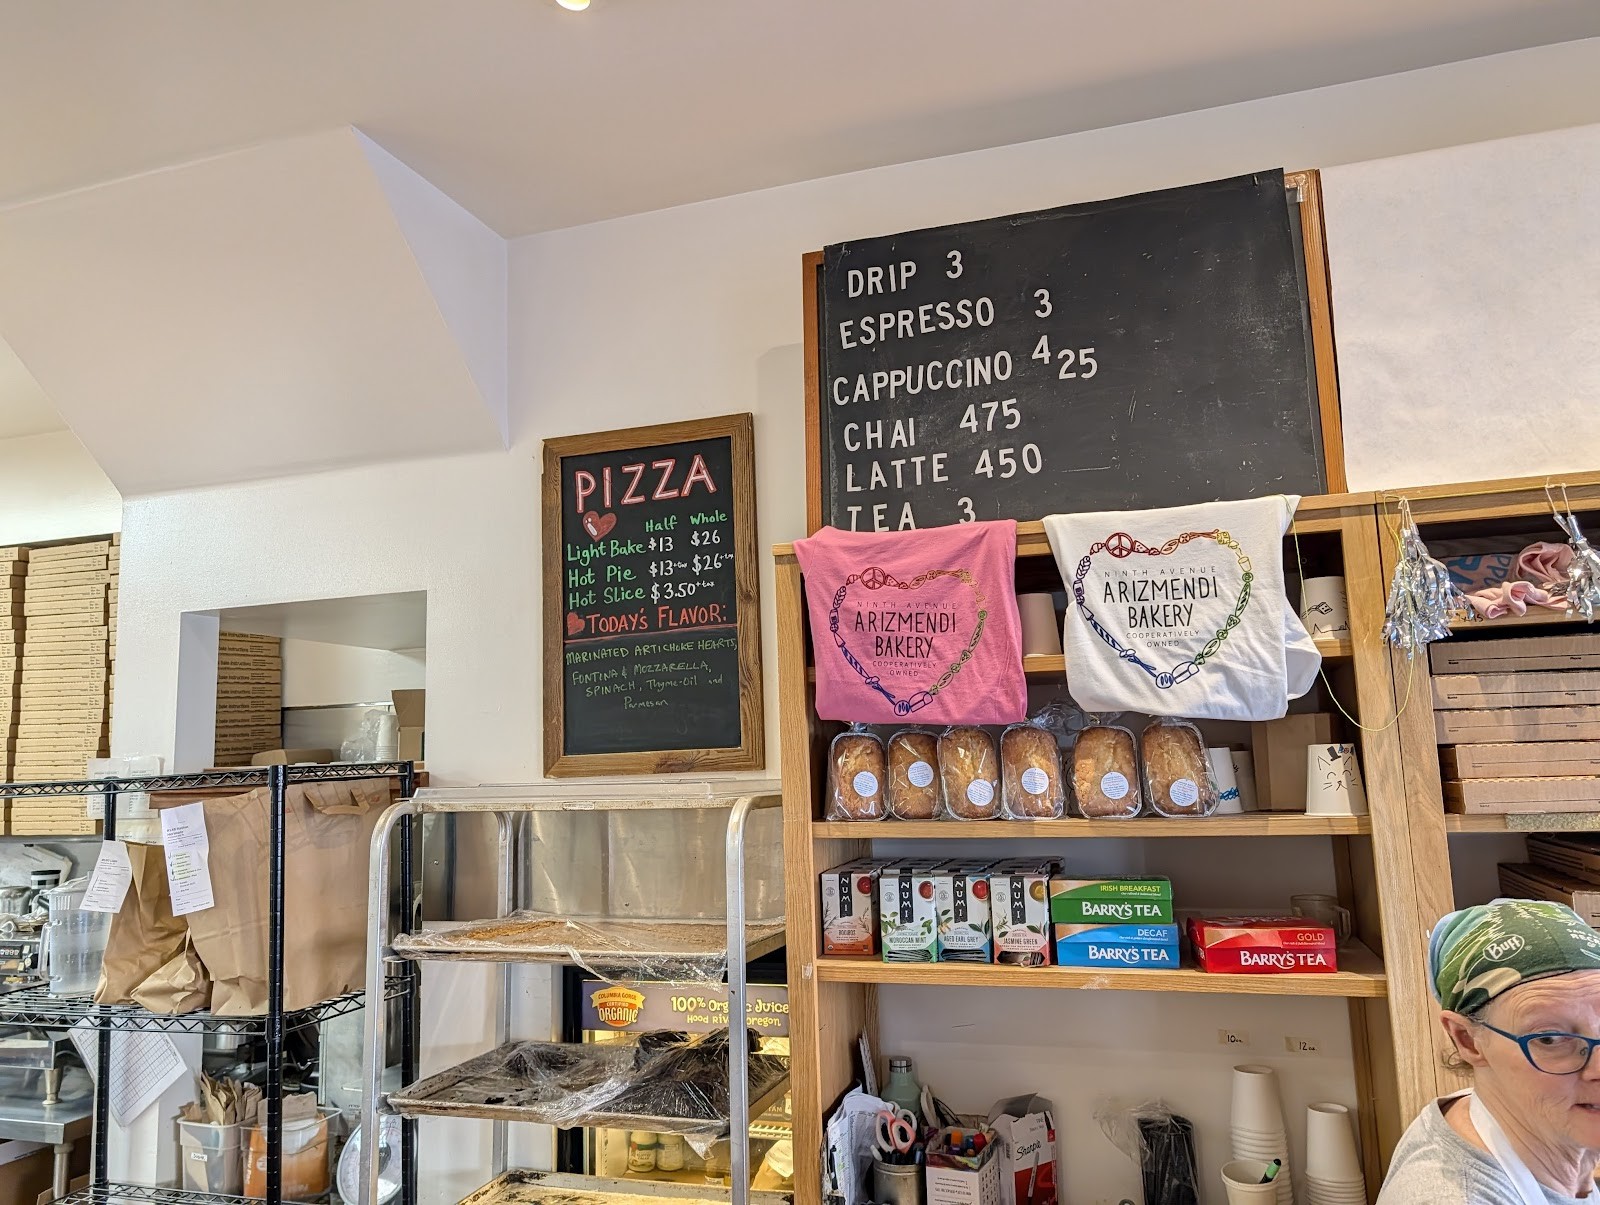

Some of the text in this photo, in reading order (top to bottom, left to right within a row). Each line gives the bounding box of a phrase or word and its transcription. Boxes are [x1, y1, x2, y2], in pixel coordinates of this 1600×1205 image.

[847, 249, 964, 298] DRIP 3
[839, 288, 1053, 350] ESPRESSO 3
[833, 334, 1099, 406] CAPPUCCINO 4 25
[843, 398, 1022, 452] CHAI 475
[845, 443, 1043, 493] LATTE 450
[575, 454, 717, 514] PIZZA
[645, 509, 728, 533] Half Whole
[847, 496, 977, 532] TEA 3
[567, 529, 721, 567] Light Bake $13 $26
[568, 567, 595, 589] Hot
[606, 565, 637, 583] Pie
[1104, 566, 1216, 578] NINTH AVENUE
[569, 589, 596, 610] Hot
[603, 586, 646, 604] Slice
[1103, 576, 1218, 604] ARIZMENDI
[657, 603, 727, 629] FLAVOR:
[857, 601, 957, 610] NINTH AVENUE
[1128, 603, 1193, 629] BAKERY
[855, 611, 956, 634] ARIZMENDI
[1126, 630, 1200, 639] COOPERATIVELY
[1146, 640, 1180, 648] OWNED
[565, 638, 738, 666] MARINATED ARTICHOKE HEARTS,
[875, 636, 934, 659] BAKERY
[572, 669, 618, 686] FONTINA
[633, 661, 712, 675] MOZZARELLA,
[872, 660, 937, 669] COOPERATIVELY
[889, 669, 919, 677] OWNED
[624, 696, 669, 710] Parmesan
[840, 877, 851, 912] NUMI
[900, 881, 912, 918] NUMI
[954, 880, 966, 917] NUMI
[1012, 881, 1024, 919] NUMI
[1119, 885, 1161, 893] BREAKFAST
[1082, 901, 1162, 920] BARRY'S TEA
[1003, 937, 1022, 945] JASMINE
[1137, 928, 1168, 938] DECAF
[1296, 933, 1325, 942] GOLD
[1088, 945, 1170, 964] BARRY'S TEA
[1486, 935, 1522, 960] Buff
[1240, 950, 1327, 970] BARRY'S TEA
[598, 992, 621, 1000] COLUMBIA
[670, 996, 706, 1013] 100%
[755, 998, 789, 1014] Juice
[598, 1007, 639, 1023] ORGANIC
[686, 1014, 709, 1025] Hood
[1015, 1139, 1042, 1161] Sharpie
